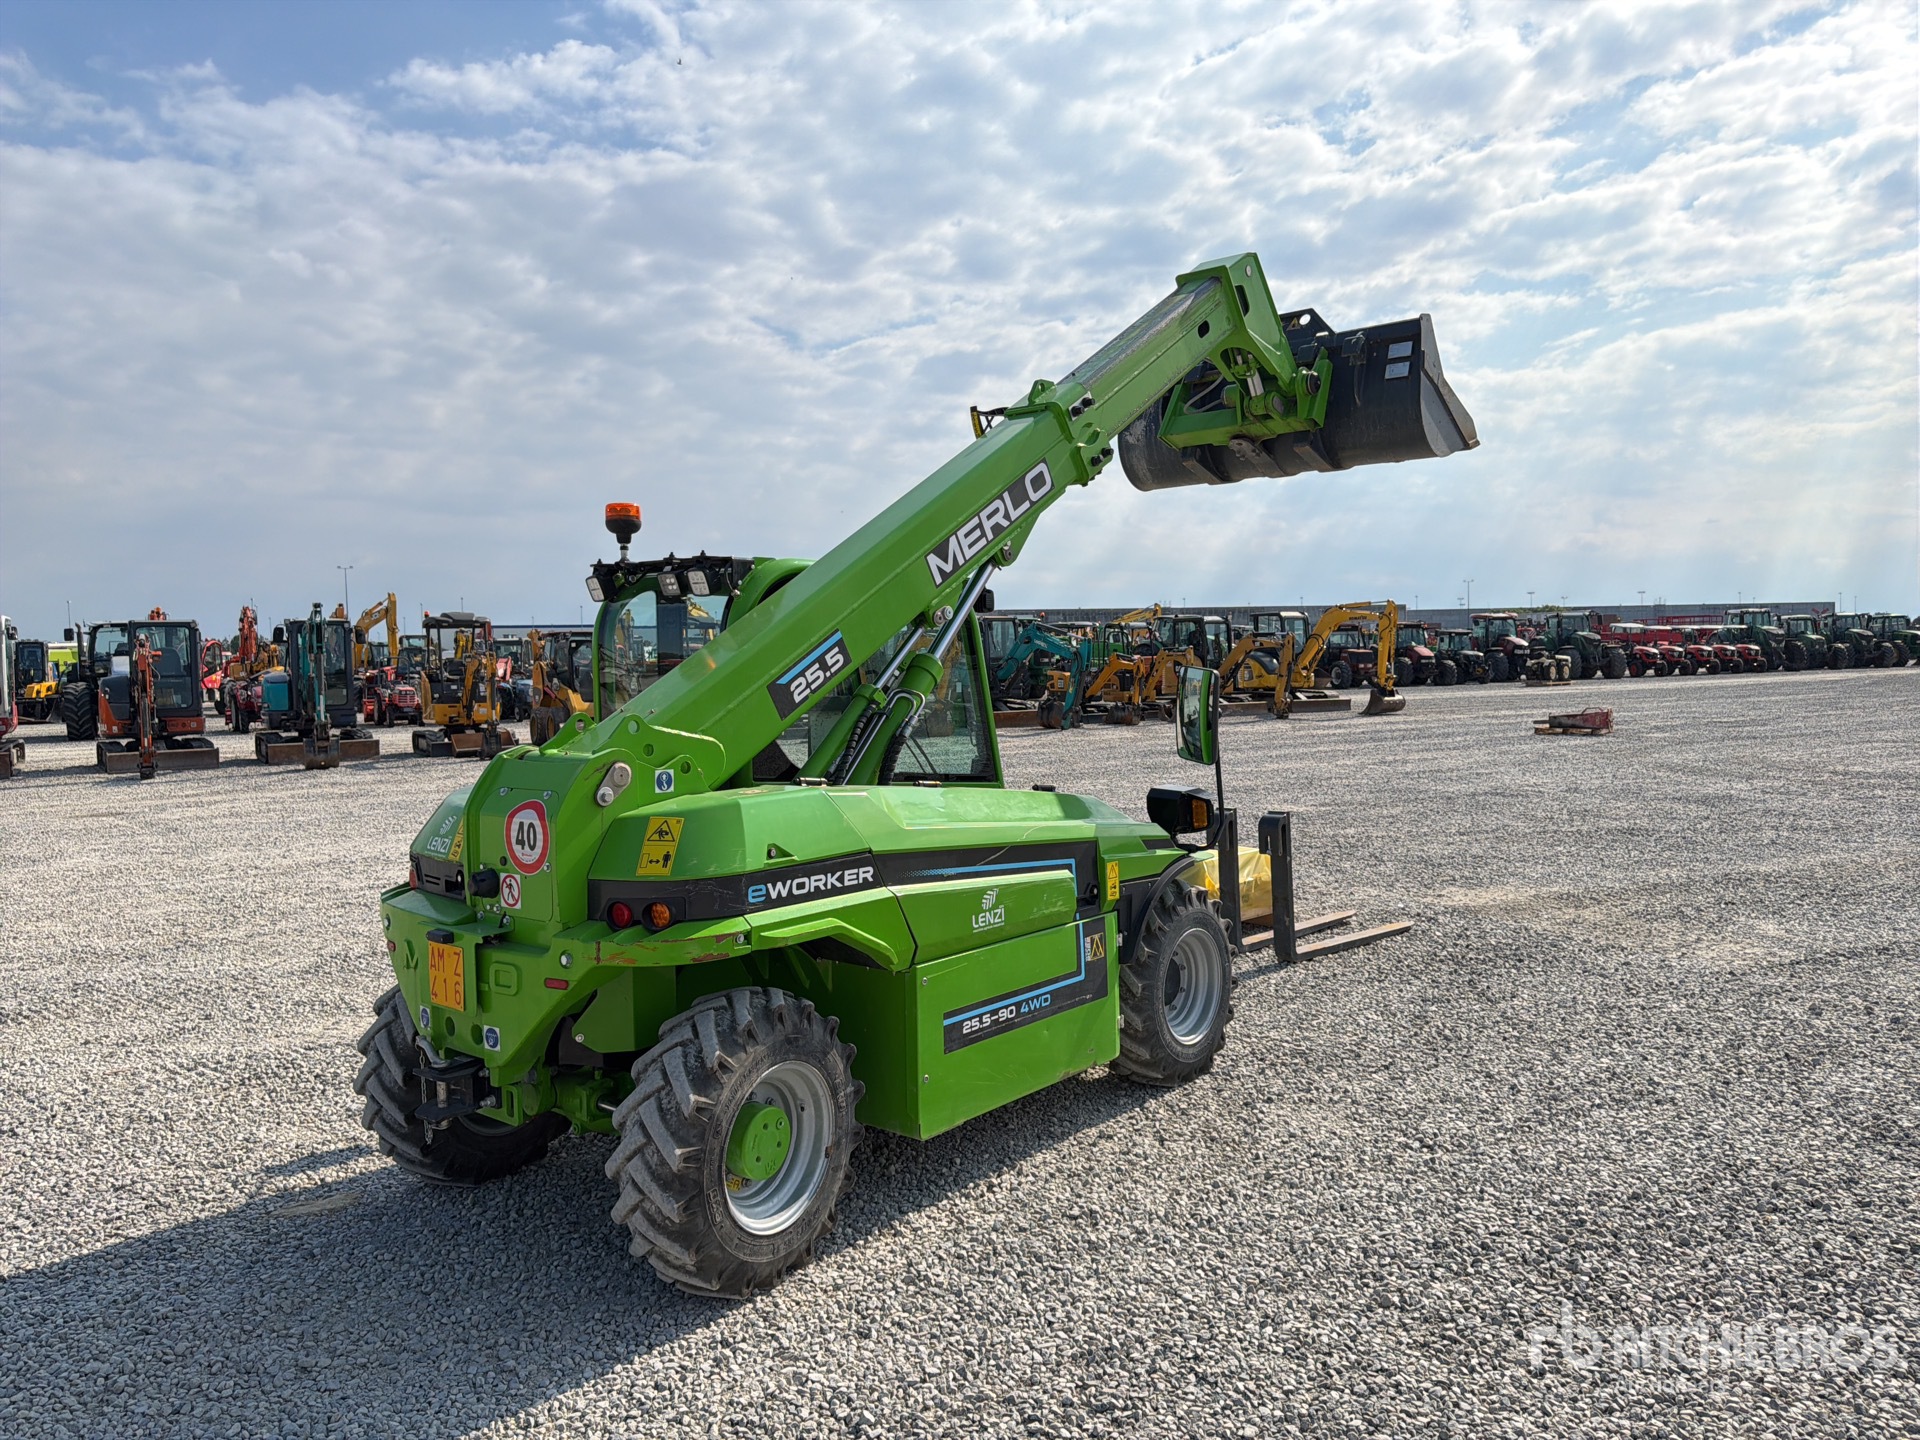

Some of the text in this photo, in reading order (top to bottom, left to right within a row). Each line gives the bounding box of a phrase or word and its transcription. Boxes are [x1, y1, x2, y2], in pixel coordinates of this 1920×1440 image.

[926, 461, 1052, 586] MERLO
[789, 646, 845, 704] 25.5
[426, 835, 452, 853] LENZI
[515, 821, 537, 852] 40
[747, 866, 874, 904] eWORKER
[972, 905, 1005, 928] LENZI
[430, 947, 445, 972] AM
[453, 952, 461, 977] Z
[431, 976, 462, 1006] 416
[962, 994, 1051, 1034] 25.5-90 4WD
